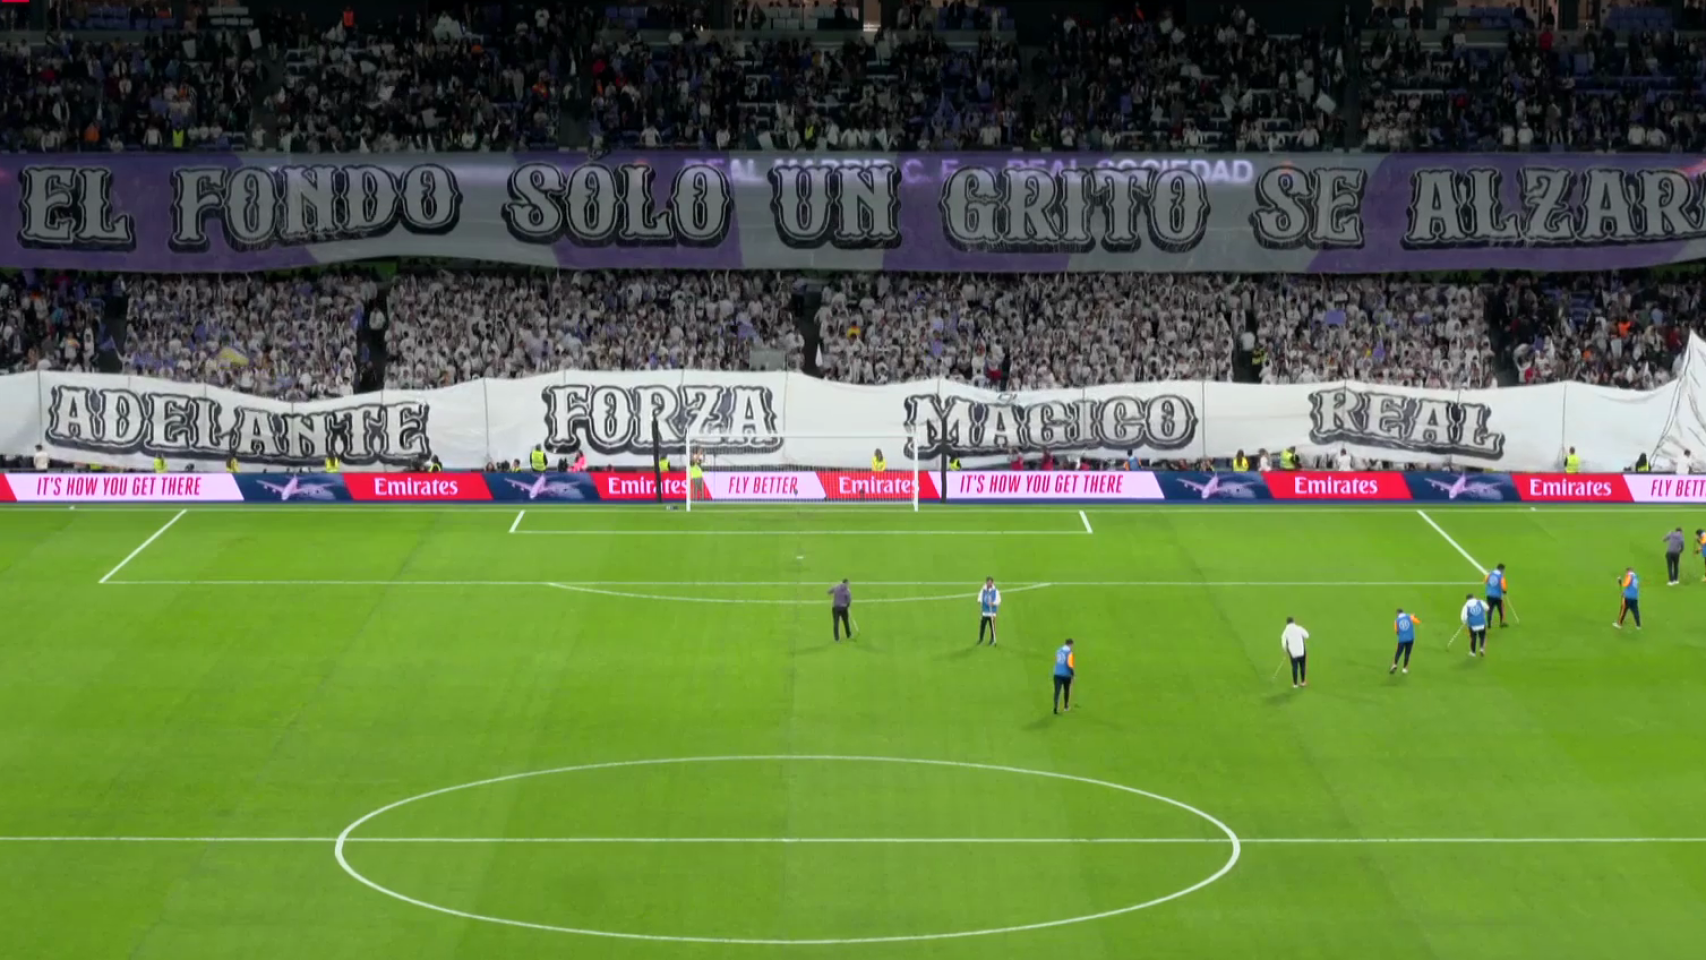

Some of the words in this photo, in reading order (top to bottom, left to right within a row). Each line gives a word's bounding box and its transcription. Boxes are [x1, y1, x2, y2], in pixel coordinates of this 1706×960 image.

[18, 166, 136, 252] EL
[168, 163, 463, 252] FONDO
[503, 163, 732, 250] SOLO
[768, 162, 902, 250] UN
[941, 166, 1211, 253] GRITO
[1249, 167, 1367, 250] SE
[1401, 167, 1706, 249] ALZAR
[45, 385, 433, 466] ADELANTE
[542, 384, 785, 454] FORZA
[1309, 388, 1505, 460] REAL
[37, 477, 62, 496] IT'S
[66, 477, 98, 496] HOW
[103, 477, 128, 496] YOU
[132, 477, 156, 496] GET
[162, 477, 201, 496] THERE
[374, 478, 458, 496] Emirates
[729, 476, 751, 494] FLY
[753, 476, 798, 495] BETTER
[960, 474, 985, 494] IT'S
[989, 474, 1021, 494] HOW
[1026, 474, 1050, 494] YOU
[1055, 474, 1079, 494] GET
[1084, 474, 1124, 494] THERE
[1295, 476, 1378, 494] Emirates
[1530, 478, 1612, 496] Emirates
[1651, 479, 1672, 497] FLY
[1675, 479, 1706, 497] BETT
